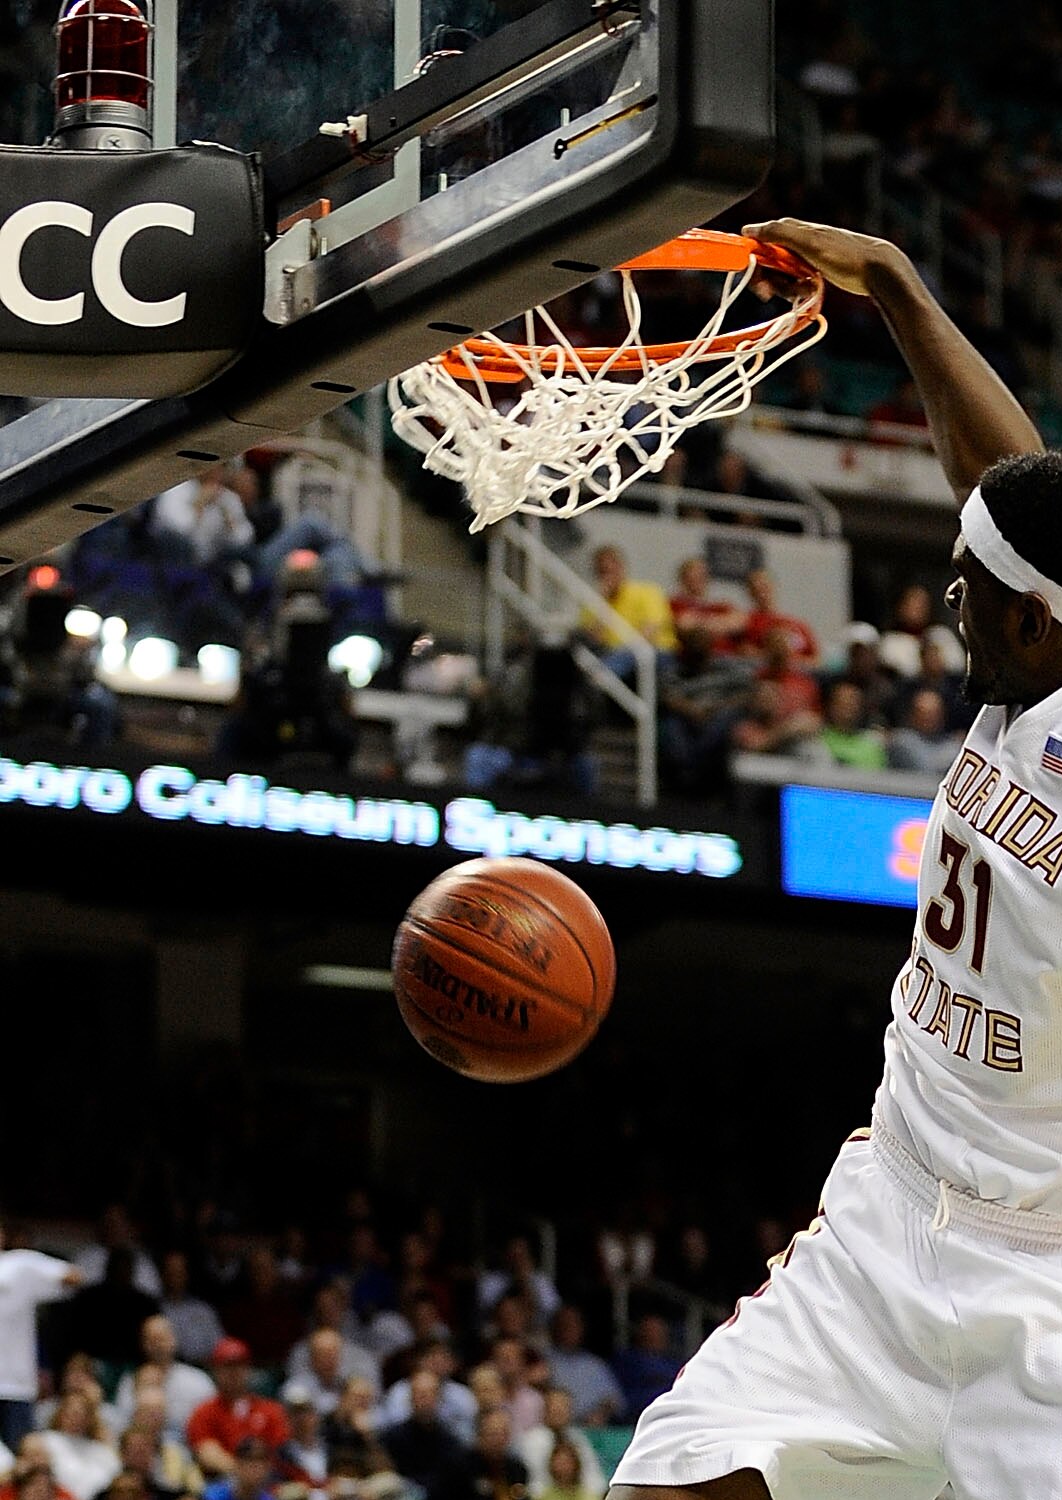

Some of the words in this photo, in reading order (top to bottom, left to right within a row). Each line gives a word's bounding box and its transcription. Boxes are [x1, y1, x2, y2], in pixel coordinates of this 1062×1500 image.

[0, 200, 196, 327] CC
[135, 764, 439, 847] Coliseum
[444, 798, 742, 878] Sponsors
[922, 824, 994, 977] 31
